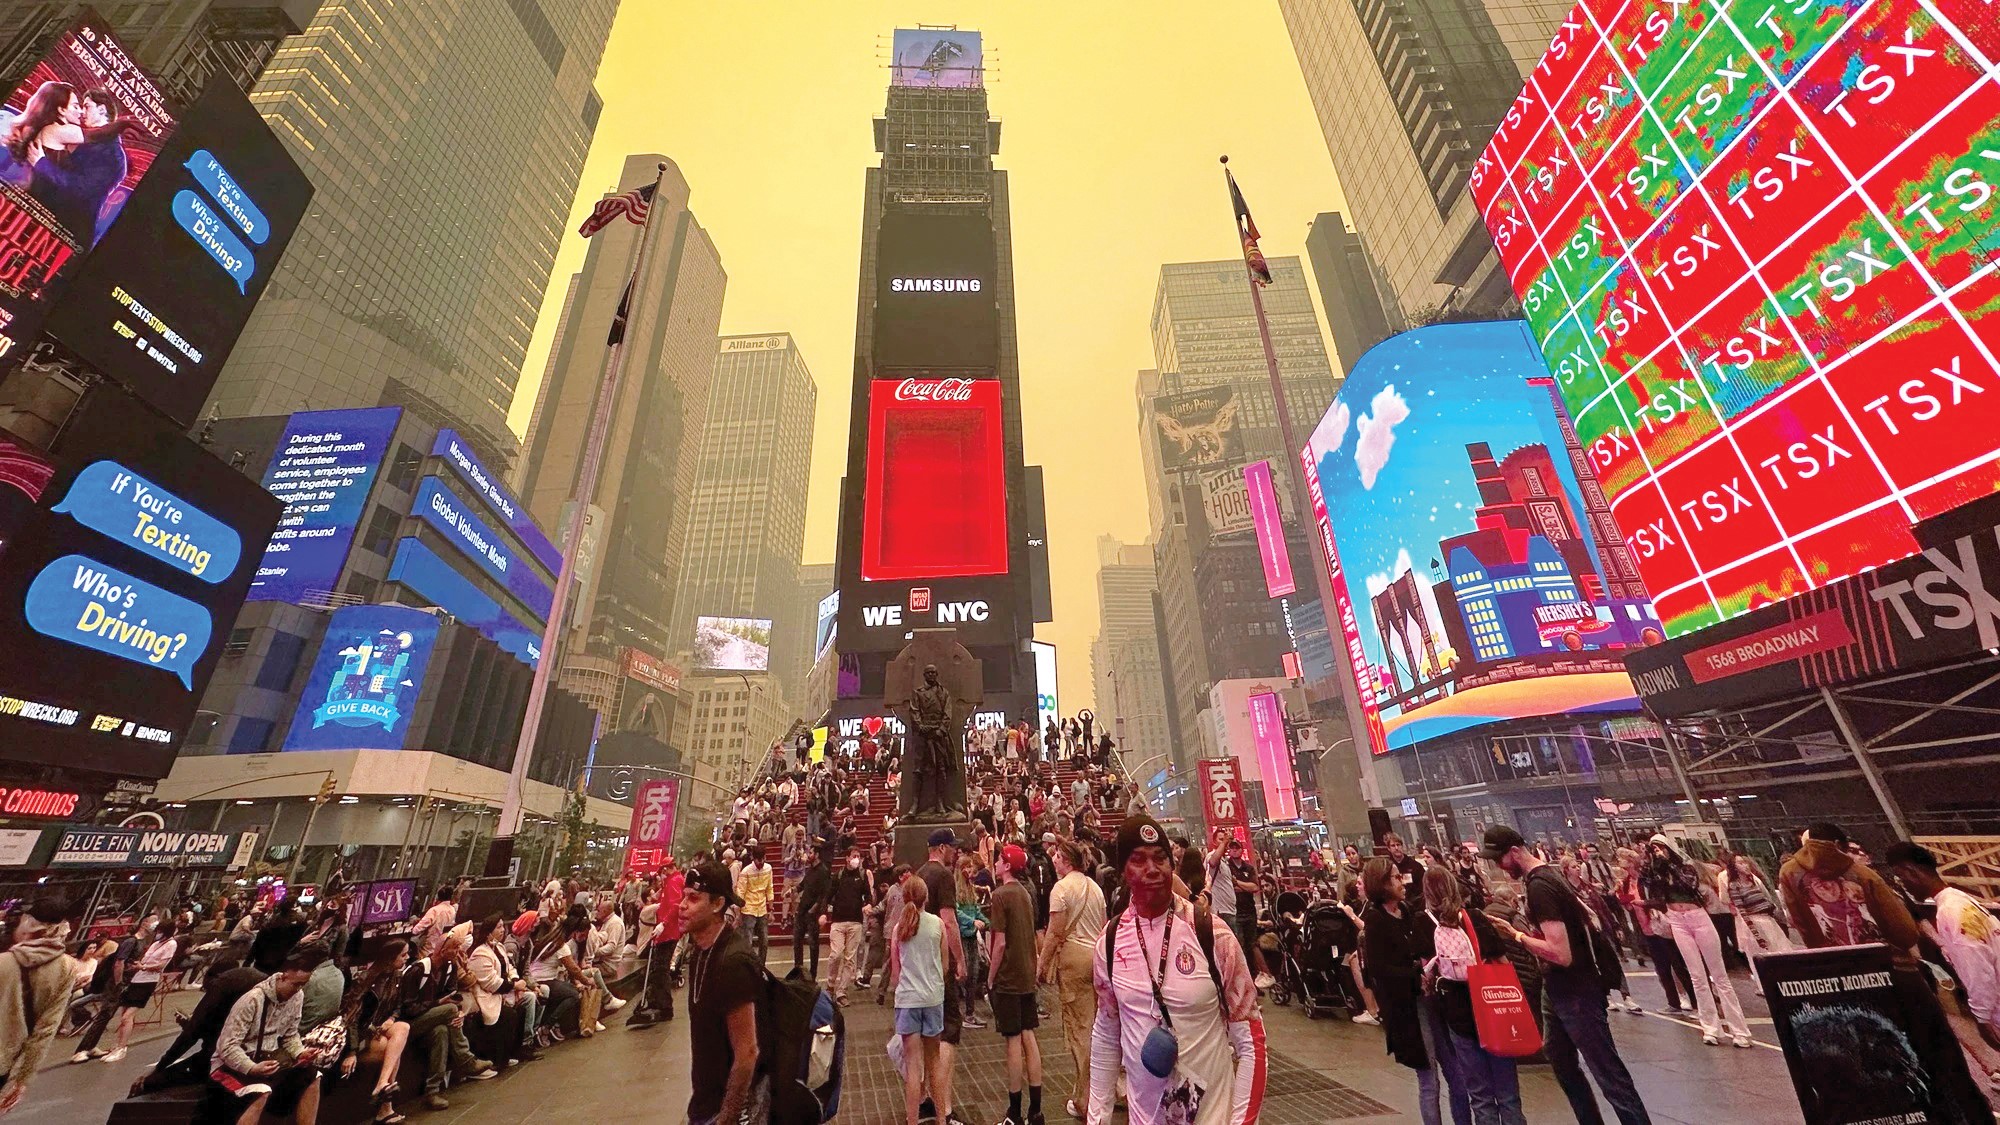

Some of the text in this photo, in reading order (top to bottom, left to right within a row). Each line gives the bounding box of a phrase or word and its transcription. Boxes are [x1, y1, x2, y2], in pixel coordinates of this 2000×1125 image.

[80, 26, 96, 41] 10
[96, 41, 127, 75] TONY
[1537, 10, 1582, 76] TSX
[69, 38, 163, 138] BEST MUSICAL!
[104, 33, 164, 104] WINNER!
[1823, 26, 1936, 128] TSX
[1496, 83, 1534, 143] TSX
[1571, 73, 1623, 139] TSX
[1674, 54, 1748, 134] TSX
[207, 159, 241, 201] If You're
[1525, 146, 1568, 204] TSX
[1610, 143, 1668, 211] TSX
[1727, 138, 1814, 220] TSX
[1904, 149, 2000, 234] TS
[190, 197, 220, 233] Who's
[217, 185, 255, 236] Texting
[193, 218, 243, 273] Driving?
[1557, 215, 1606, 272] TSX
[1653, 224, 1721, 291] TSX
[891, 278, 981, 293] SAMSUNG
[1522, 272, 1555, 323] TSX
[1790, 237, 1893, 320] TSX
[728, 338, 765, 350] Allianz
[1594, 291, 1648, 348] TSX
[1553, 344, 1590, 394] TSX
[1703, 317, 1782, 383] TSX
[894, 377, 976, 401] Coca-Cola
[1634, 378, 1697, 434] TSX
[1863, 355, 1986, 436] TSX
[279, 455, 338, 467] of volunteer
[285, 441, 366, 456] dedicated month
[290, 432, 343, 446] During this
[1588, 425, 1630, 474] TSX
[1760, 424, 1853, 490] TSX
[269, 478, 354, 491] come together to
[273, 465, 368, 480] service, employees
[317, 490, 336, 500] the
[449, 440, 515, 520] Morgan Stanley Gives Back
[1209, 467, 1246, 494] LITTLE
[109, 471, 184, 525] If You're
[282, 516, 305, 526] with
[310, 503, 331, 513] can
[1681, 477, 1753, 532] TSX
[132, 511, 212, 576] Texting
[265, 542, 291, 553] lobe.
[271, 526, 337, 540] rofits around
[431, 491, 508, 573] Global Volunteer Month
[1627, 517, 1675, 564] TSX
[72, 565, 138, 609] Who's
[258, 566, 289, 577] Stanley
[912, 591, 929, 600] BROAD
[1869, 534, 2000, 650] TSX
[862, 601, 990, 628] WE NYC
[912, 599, 928, 608] WAY
[1535, 601, 1594, 624] HERSHEY'S
[76, 601, 188, 663] Driving?
[1706, 625, 1822, 671] 1568 BROADWAY
[1348, 638, 1376, 708] INSIDE!
[326, 702, 393, 719] GIVE BACK
[838, 718, 863, 738] WE
[4, 788, 79, 817] CAMINOS
[640, 785, 671, 842] tkts
[1208, 763, 1236, 820] tkts
[62, 834, 136, 852] BLUE FIN
[138, 832, 229, 853] NOW OPEN
[142, 854, 158, 865] FOR
[158, 855, 180, 865] LUNC
[1483, 989, 1519, 1000] Nintendo
[1777, 972, 1894, 998] MIDNIGHT MOMENT
[1493, 1008, 1508, 1016] NEW
[1905, 1111, 1928, 1124] ARTS
